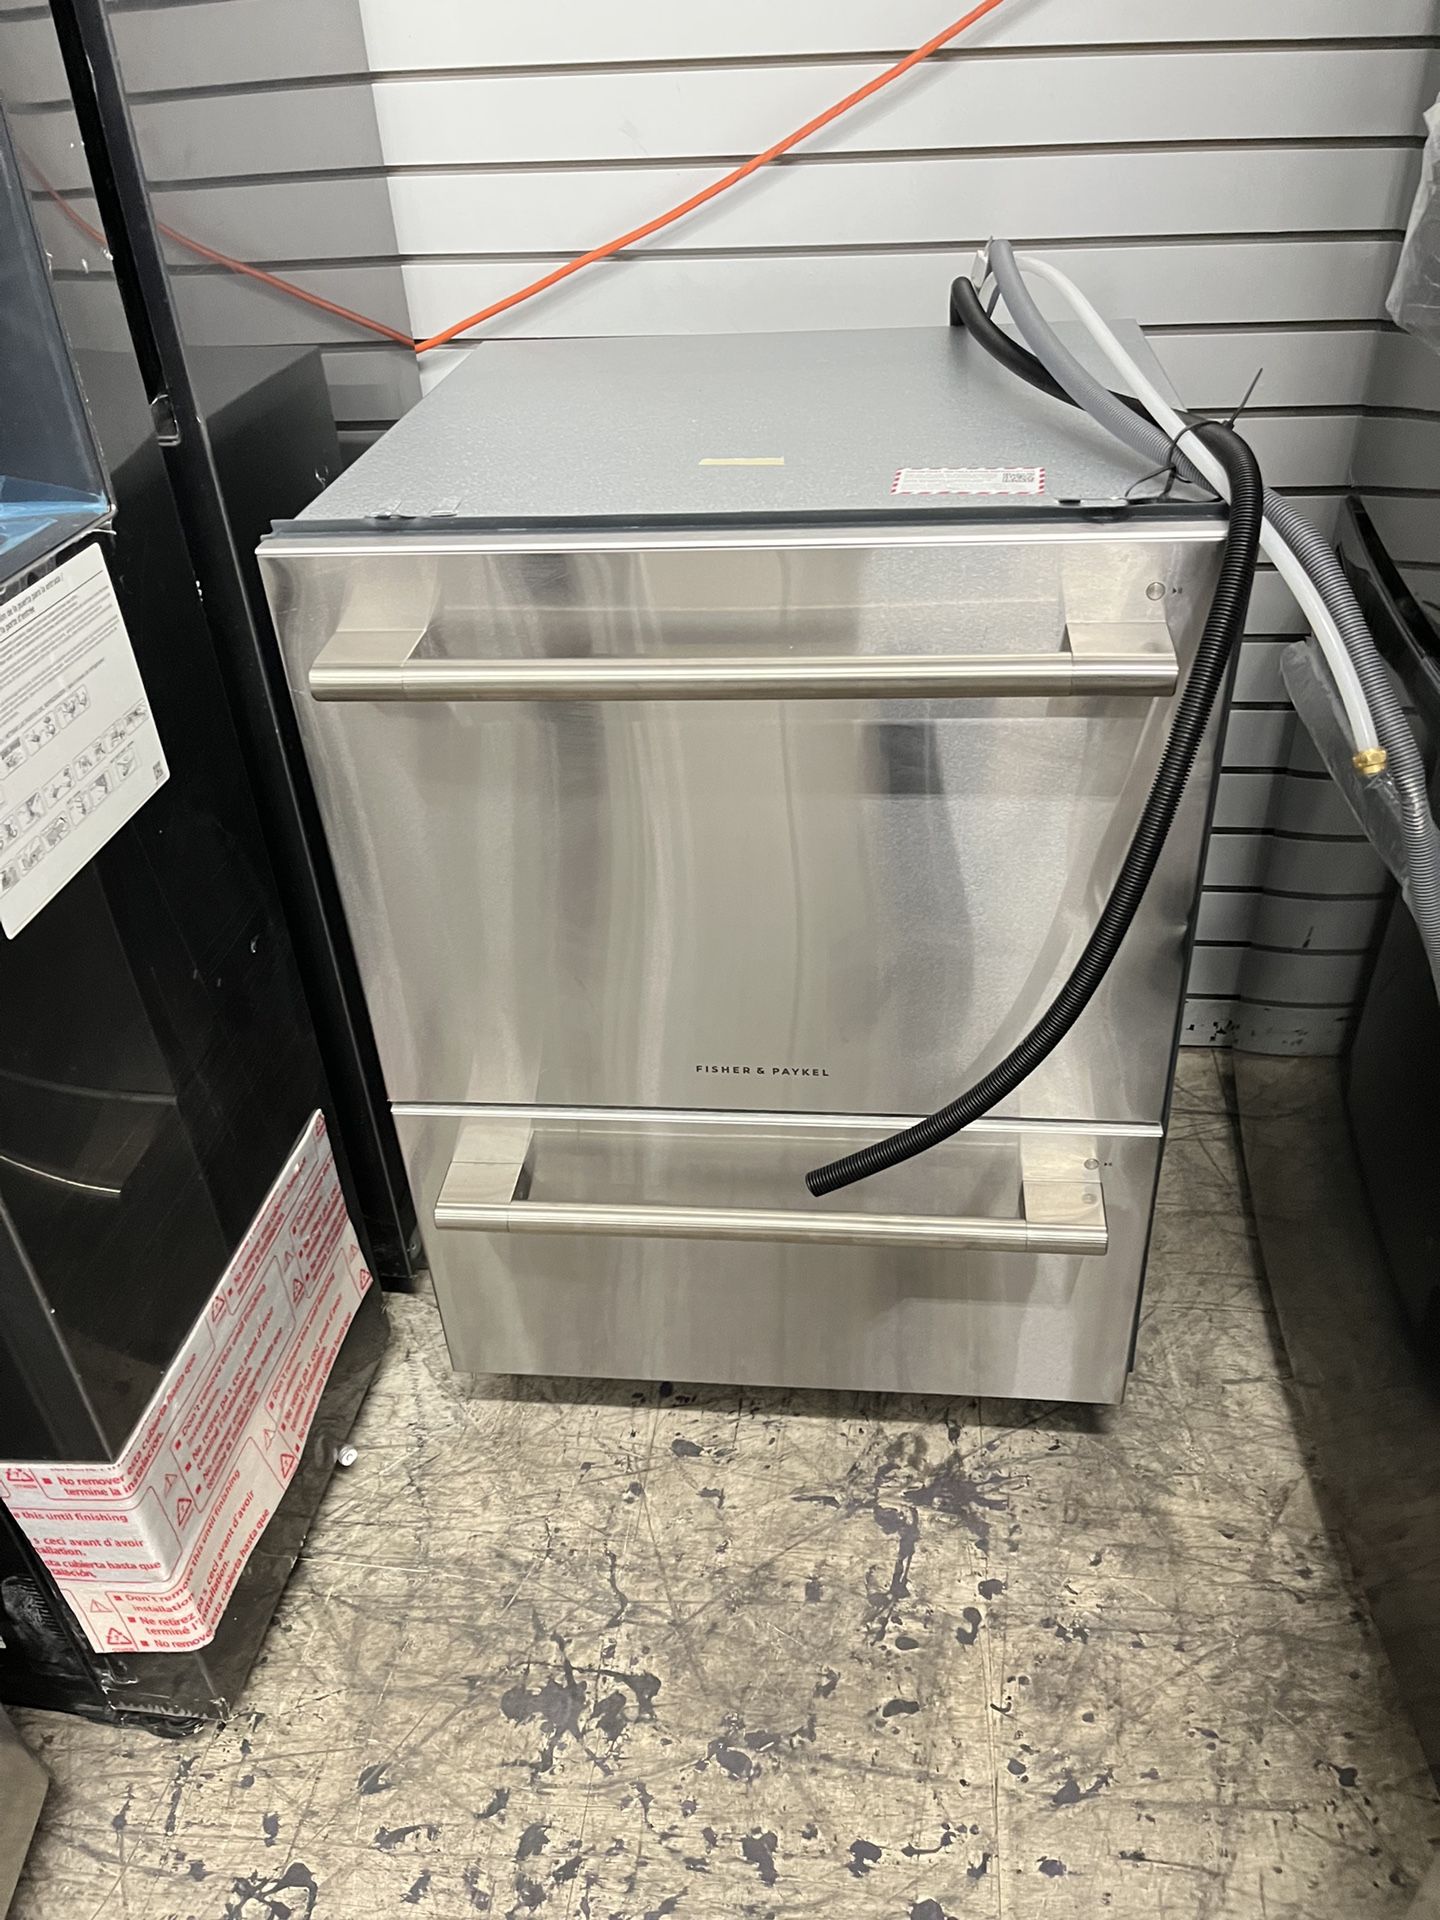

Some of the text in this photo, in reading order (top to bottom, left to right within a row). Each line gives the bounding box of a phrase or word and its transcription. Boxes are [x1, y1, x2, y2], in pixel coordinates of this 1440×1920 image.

[696, 1065, 829, 1076] FISHER & PAYKEL
[57, 1476, 75, 1485] No
[78, 1474, 125, 1485] remover
[127, 1451, 142, 1475] esta
[64, 1487, 109, 1496] termine
[111, 1487, 122, 1496] la
[22, 1511, 44, 1520] this
[46, 1512, 74, 1521] until
[75, 1512, 129, 1523] finishing
[125, 1470, 240, 1603] Don't remove this until finishing
[44, 1537, 66, 1545] ceci
[69, 1539, 101, 1548] avant
[62, 1560, 106, 1570] cubierta
[106, 1560, 137, 1570] hasta
[138, 1561, 162, 1571] que
[139, 1616, 156, 1625] Ne
[159, 1612, 197, 1626] retirez
[207, 1560, 219, 1585] ceci
[217, 1528, 234, 1560] avant
[153, 1639, 170, 1648] No
[211, 1602, 222, 1625] esta
[221, 1558, 242, 1601] cubierta
[240, 1528, 258, 1557] hasta
[256, 1509, 270, 1529] que
[145, 1626, 191, 1636] terminé
